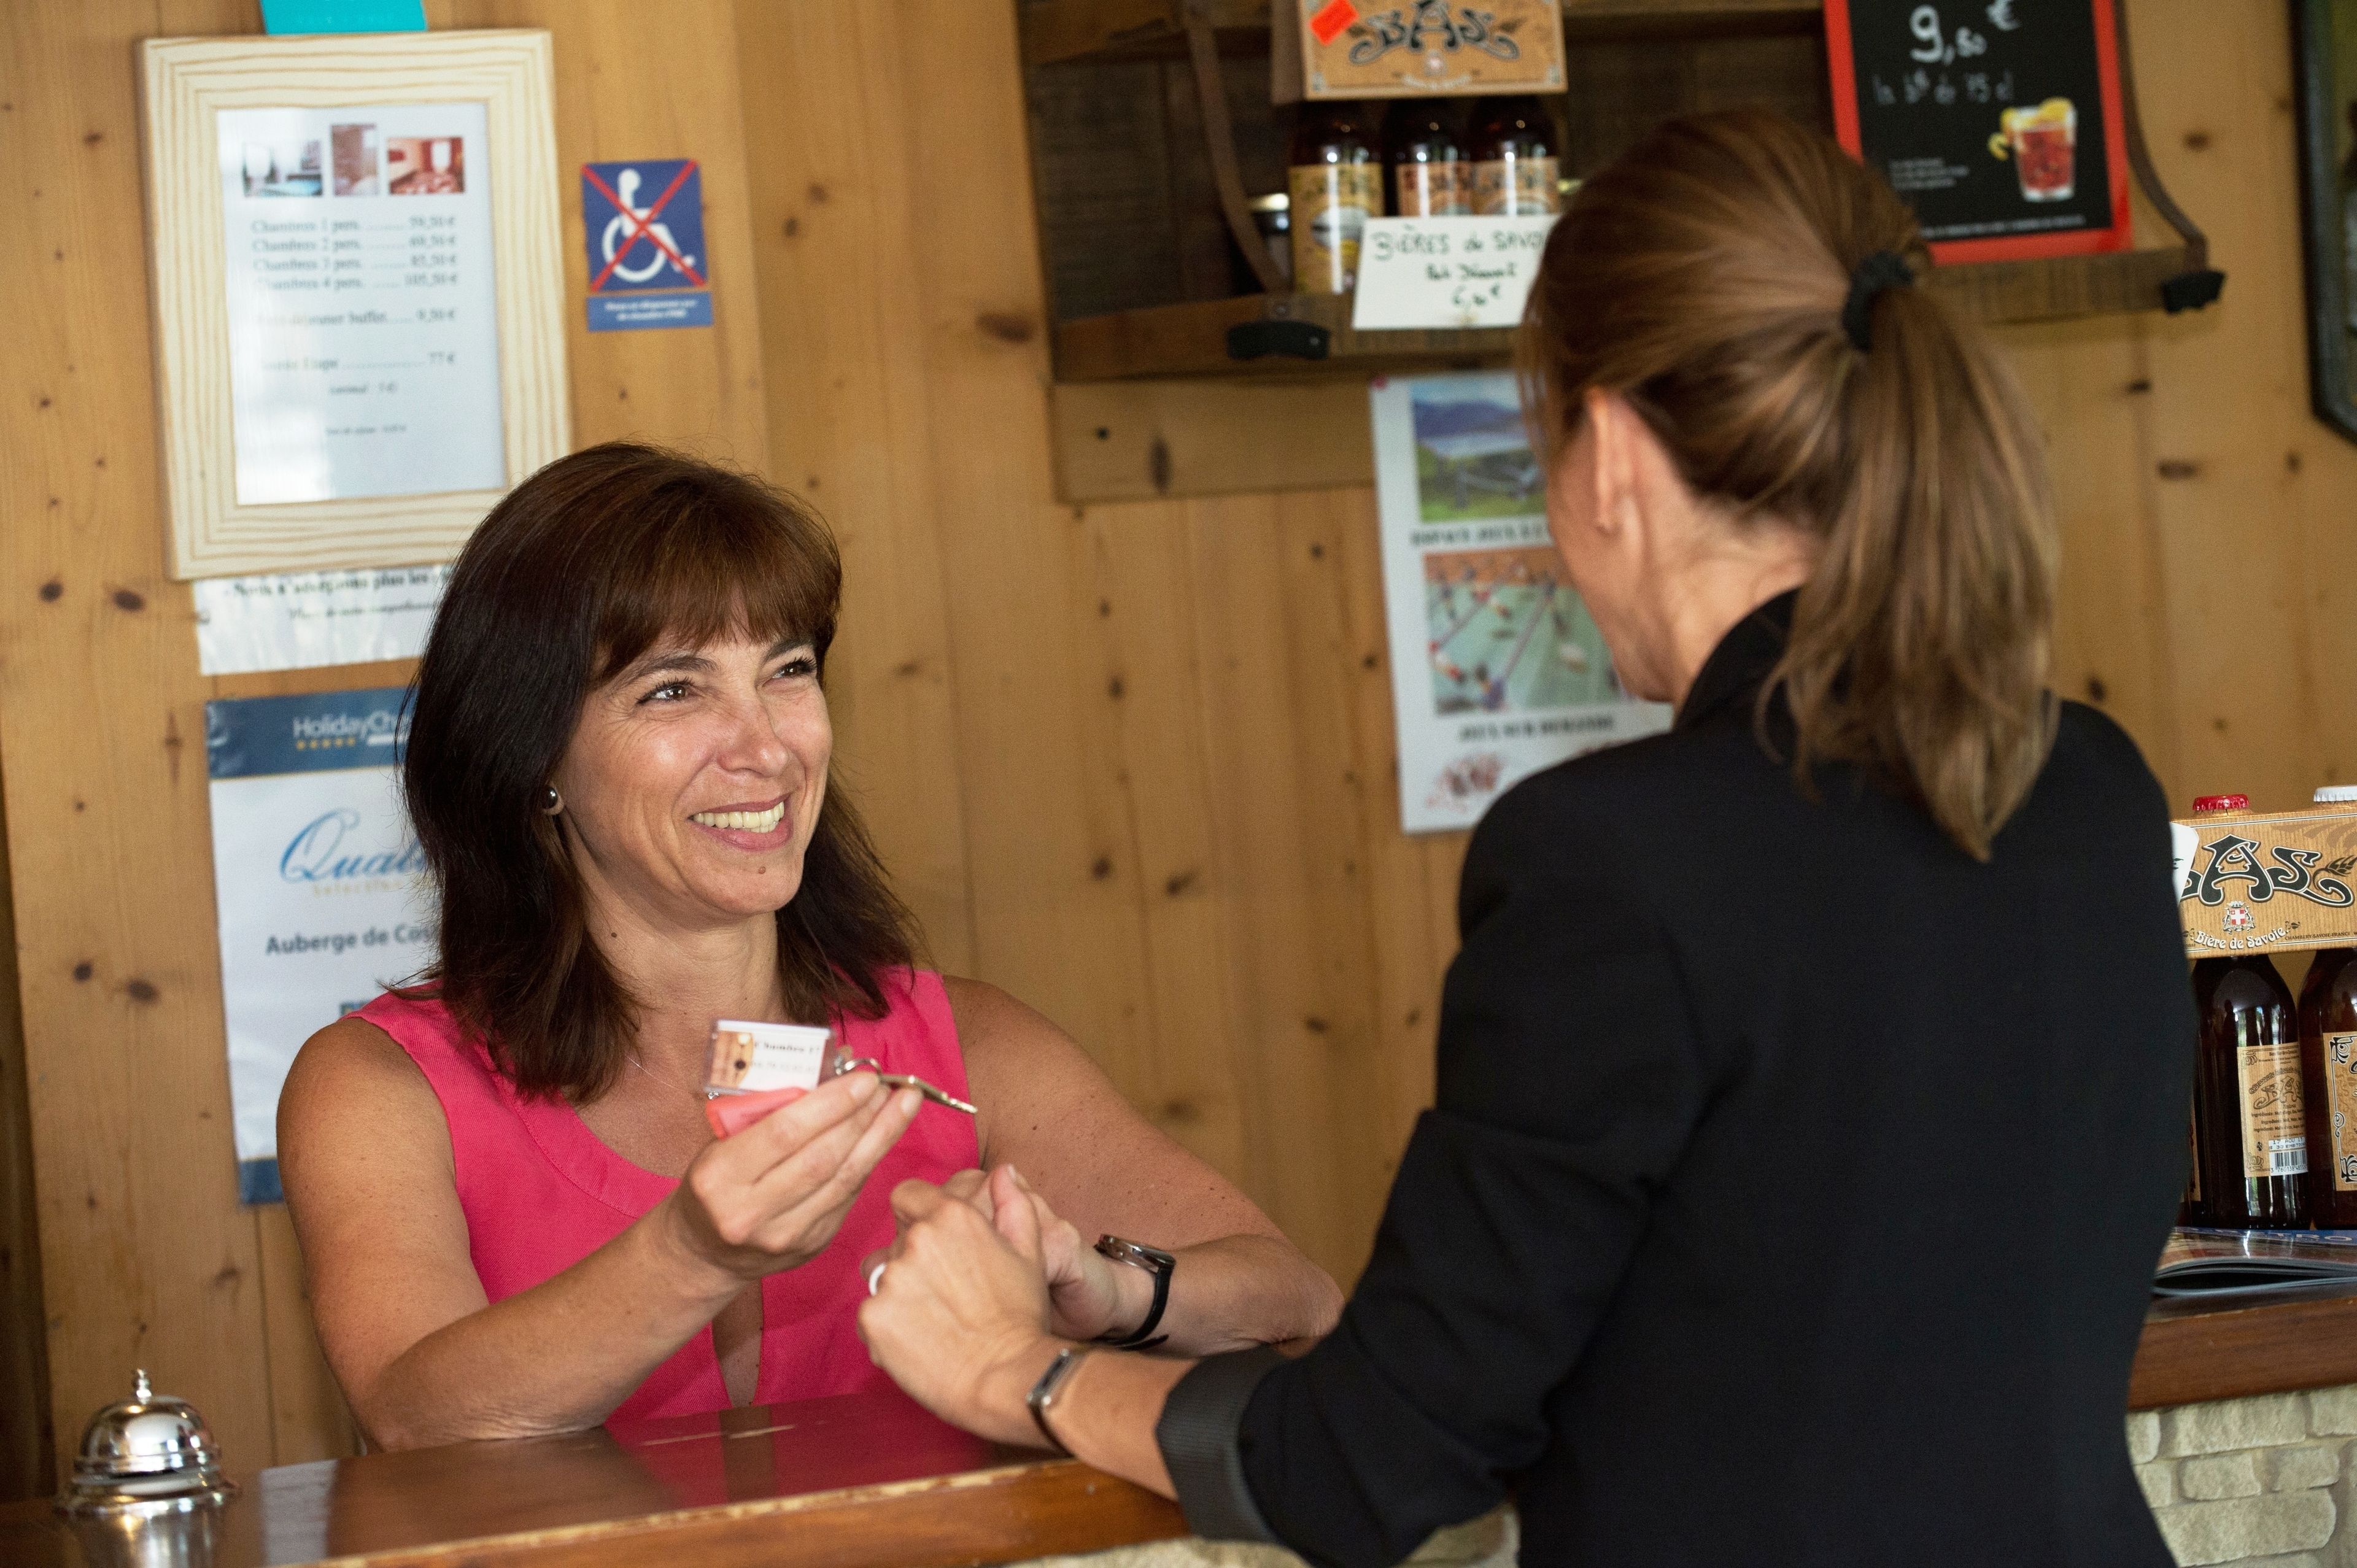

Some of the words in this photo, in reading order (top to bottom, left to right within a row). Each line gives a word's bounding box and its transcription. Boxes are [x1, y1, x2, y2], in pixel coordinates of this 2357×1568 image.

[2195, 930, 2226, 949] Bière
[2229, 938, 2244, 950] de
[2246, 927, 2286, 948] Savoie
